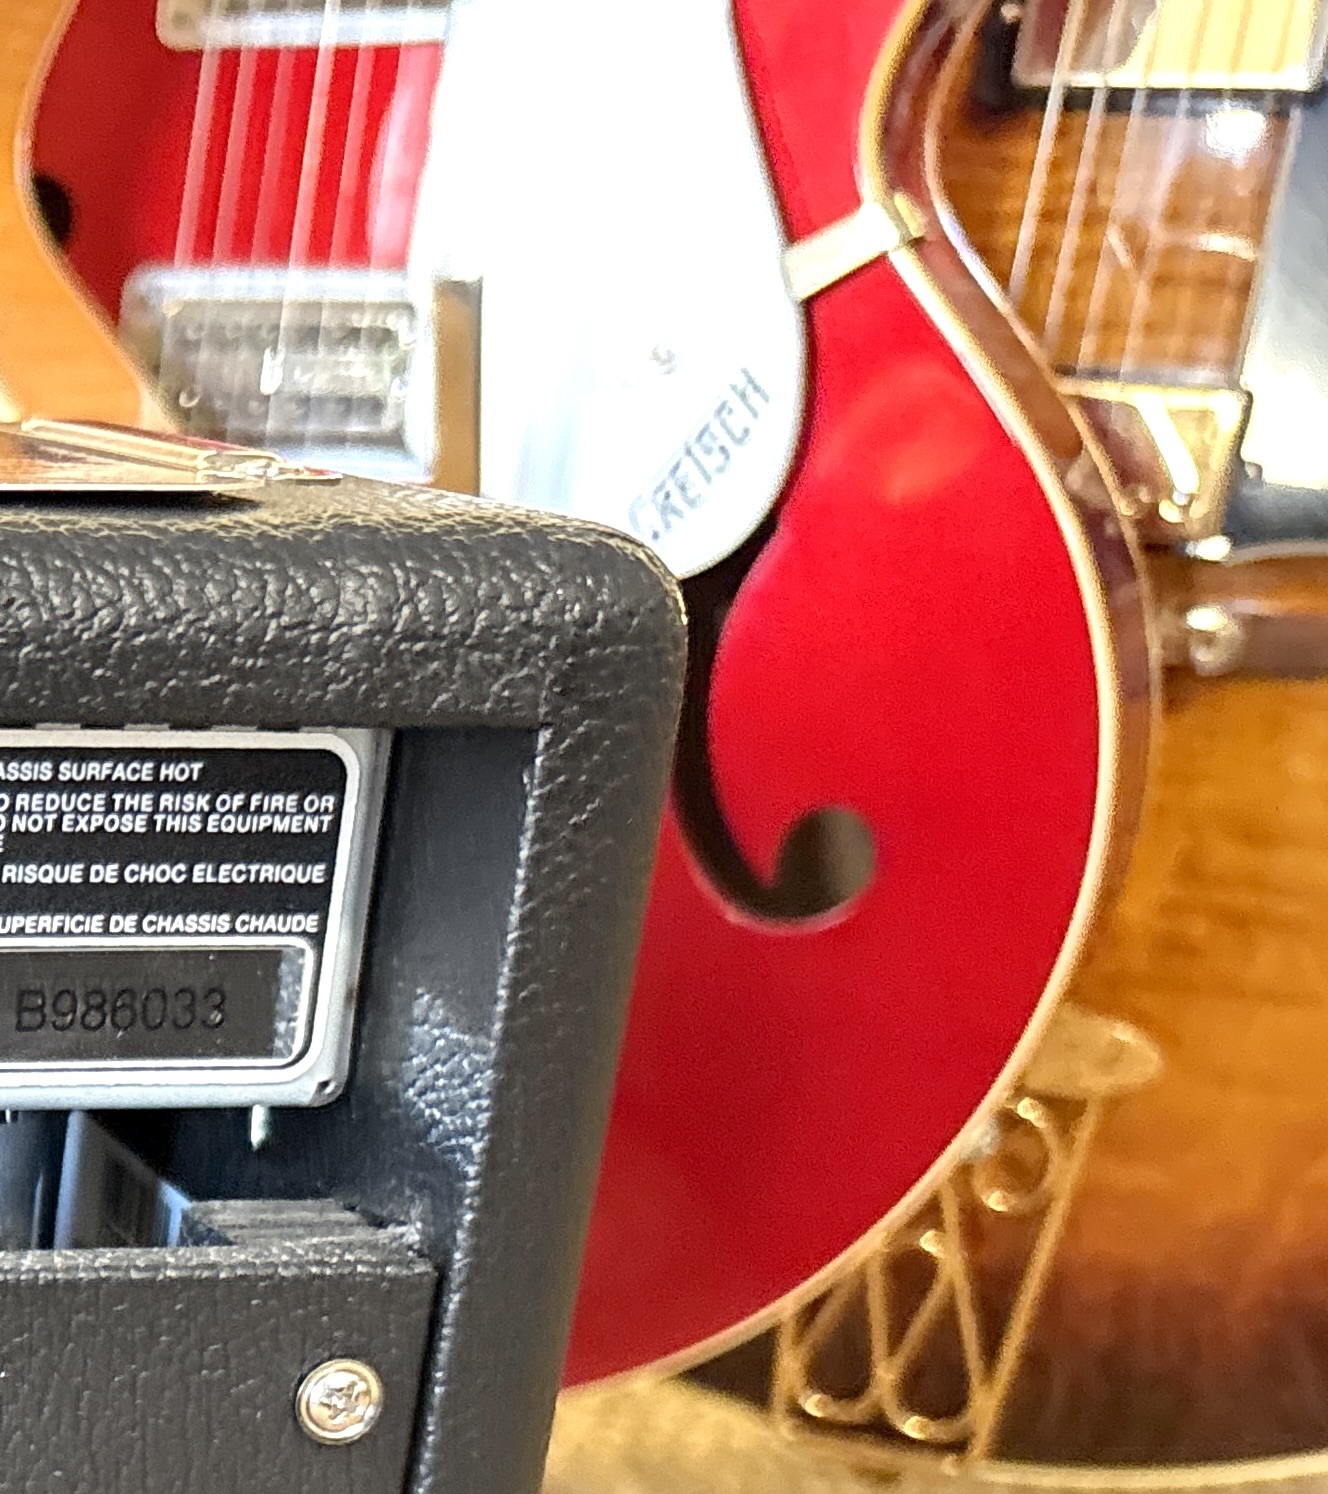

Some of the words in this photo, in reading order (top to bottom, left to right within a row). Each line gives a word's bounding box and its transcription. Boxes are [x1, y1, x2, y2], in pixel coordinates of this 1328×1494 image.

[58, 762, 154, 782] SURFACE
[159, 762, 204, 782] HOT
[15, 793, 106, 813] REDUCE
[111, 793, 153, 813] THE
[159, 793, 210, 813] RISK
[216, 793, 244, 813] OF
[249, 793, 298, 813] FIRE
[303, 793, 336, 813] OR
[11, 814, 57, 834] NOT
[62, 814, 147, 834] EXPOSE
[153, 814, 202, 834] THIS
[207, 814, 333, 834] EQUIPMENT
[1, 863, 85, 884] RISQUE
[89, 863, 119, 884] DE
[123, 863, 187, 884] CHOC
[192, 863, 327, 884] ELECTRIQUE
[110, 914, 138, 935] DE
[142, 914, 231, 935] CHASSIS
[235, 914, 319, 935] CHAUDE
[14, 986, 227, 1033] B986033
